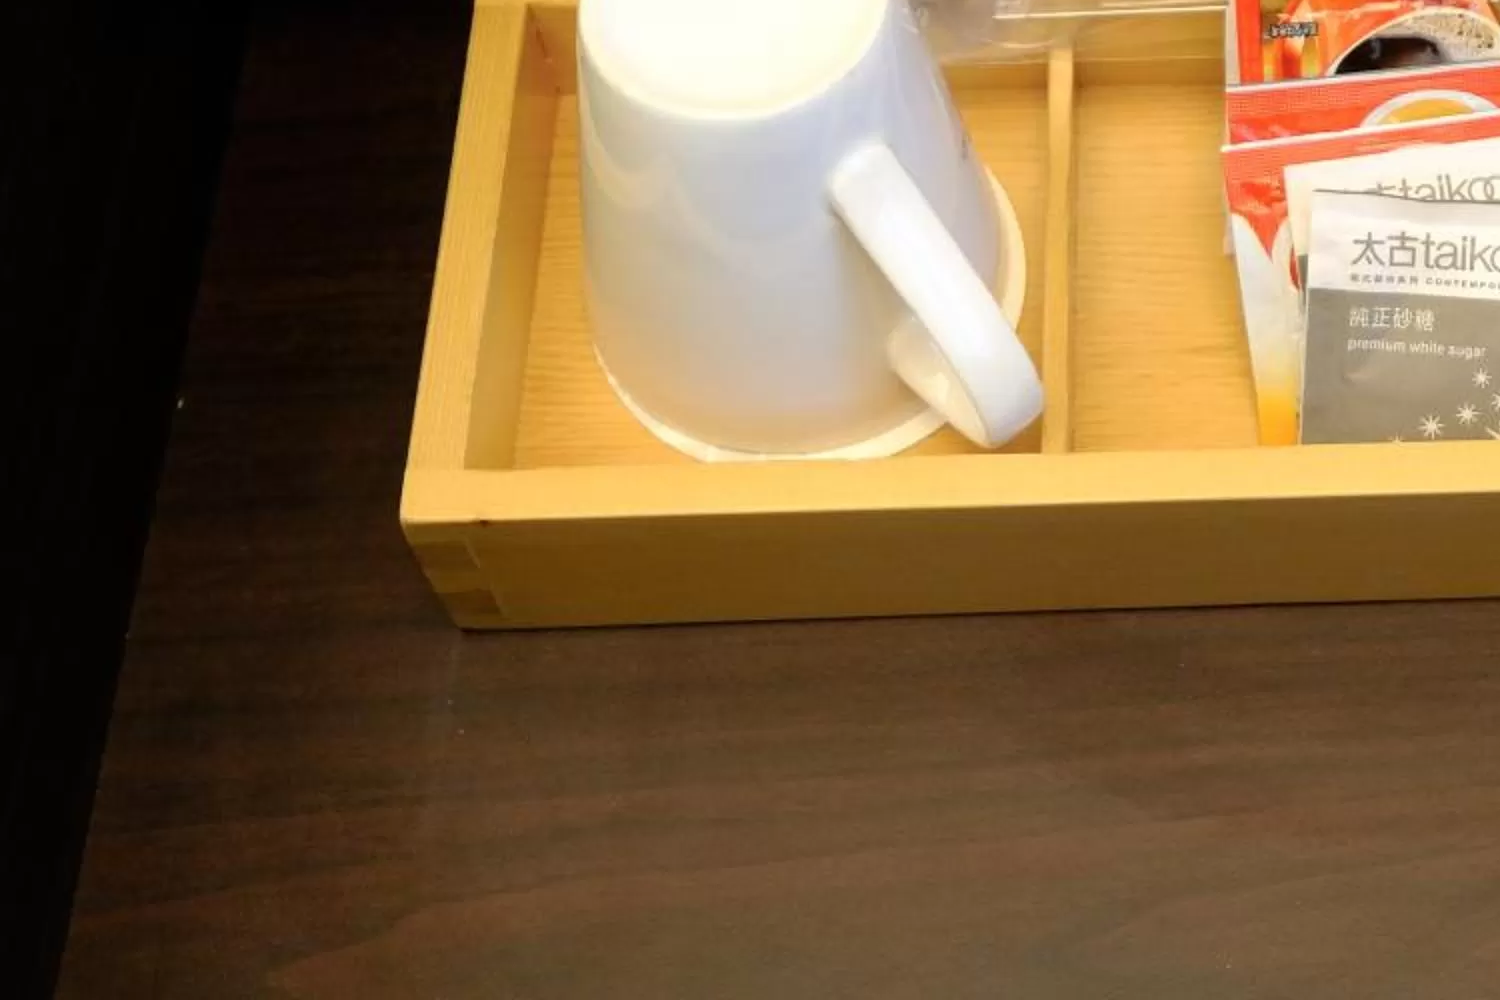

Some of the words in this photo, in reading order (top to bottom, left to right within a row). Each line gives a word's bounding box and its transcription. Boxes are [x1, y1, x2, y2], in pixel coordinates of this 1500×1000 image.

[1347, 338, 1406, 353] premium
[1409, 339, 1445, 355] white
[1447, 344, 1486, 360] sugar
